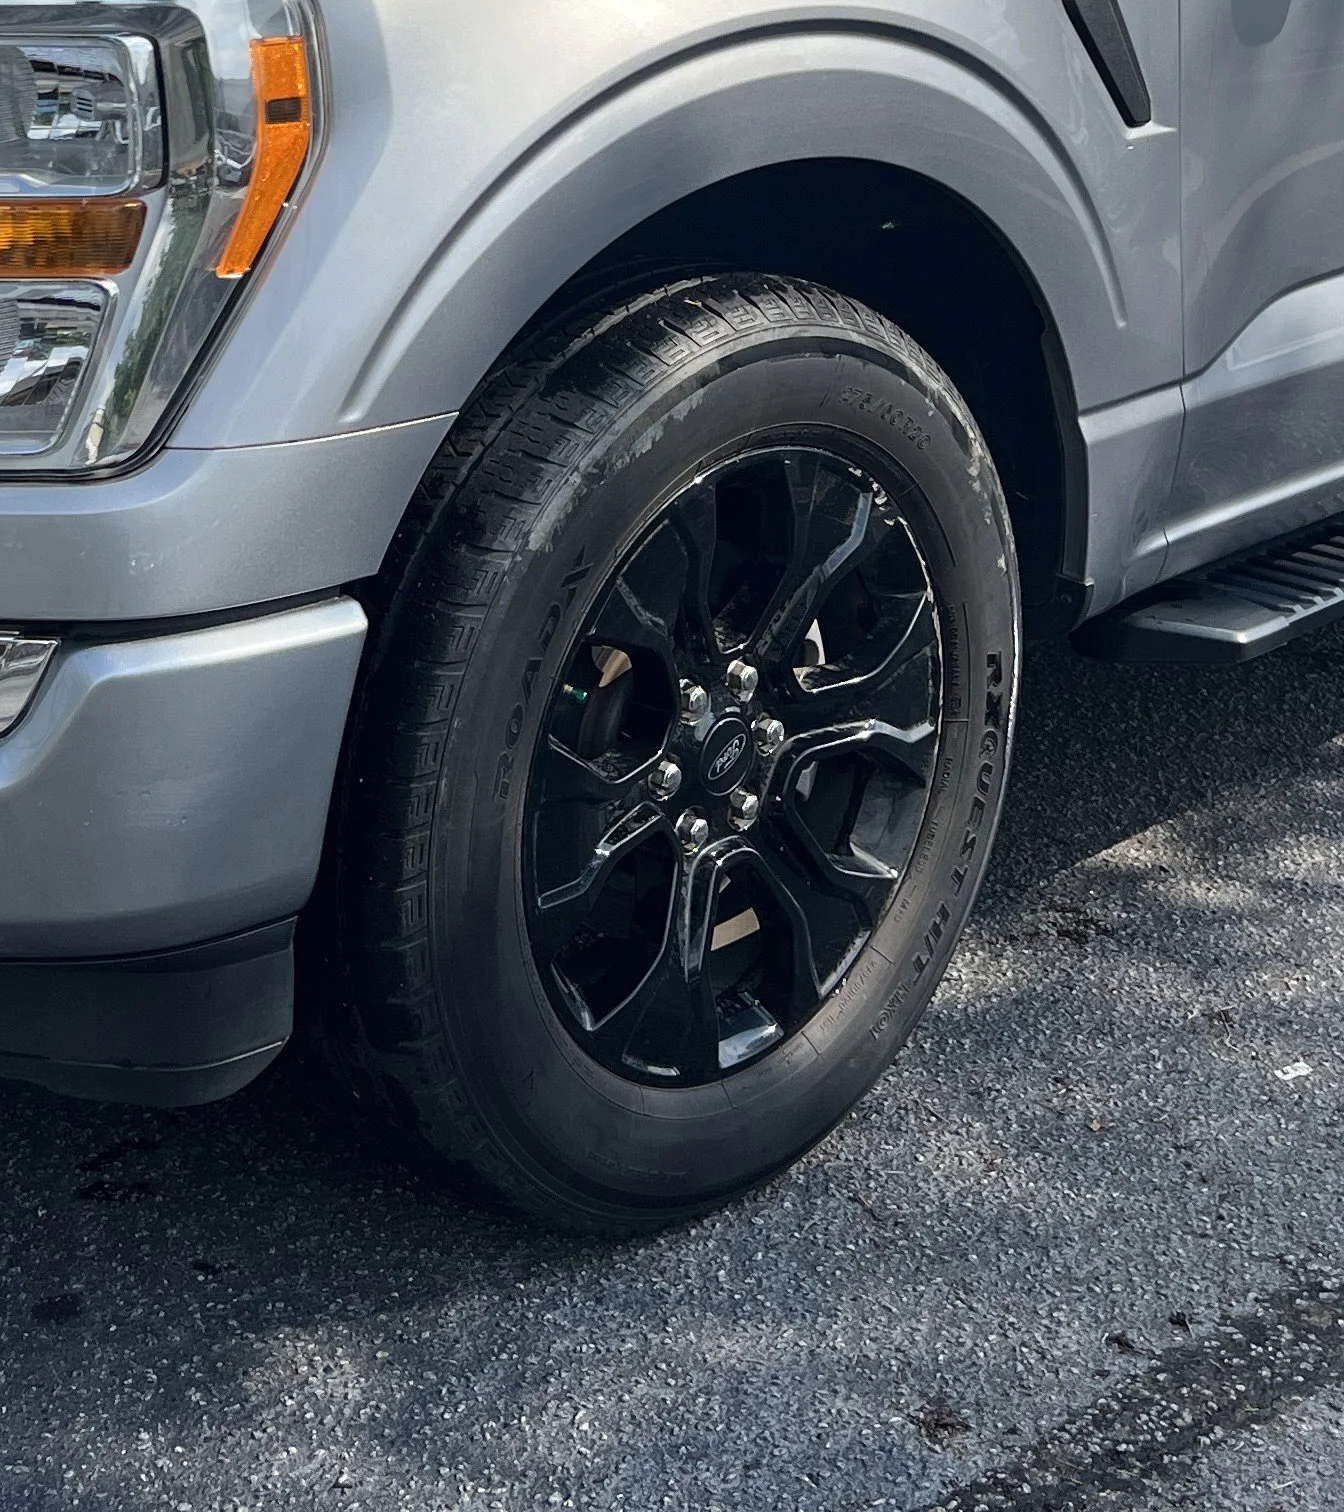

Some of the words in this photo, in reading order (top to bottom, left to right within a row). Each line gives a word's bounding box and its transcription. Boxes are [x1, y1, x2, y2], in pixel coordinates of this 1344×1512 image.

[492, 544, 595, 802] ROADX
[715, 738, 741, 774] Ford
[950, 650, 1004, 897] RXQUEST
